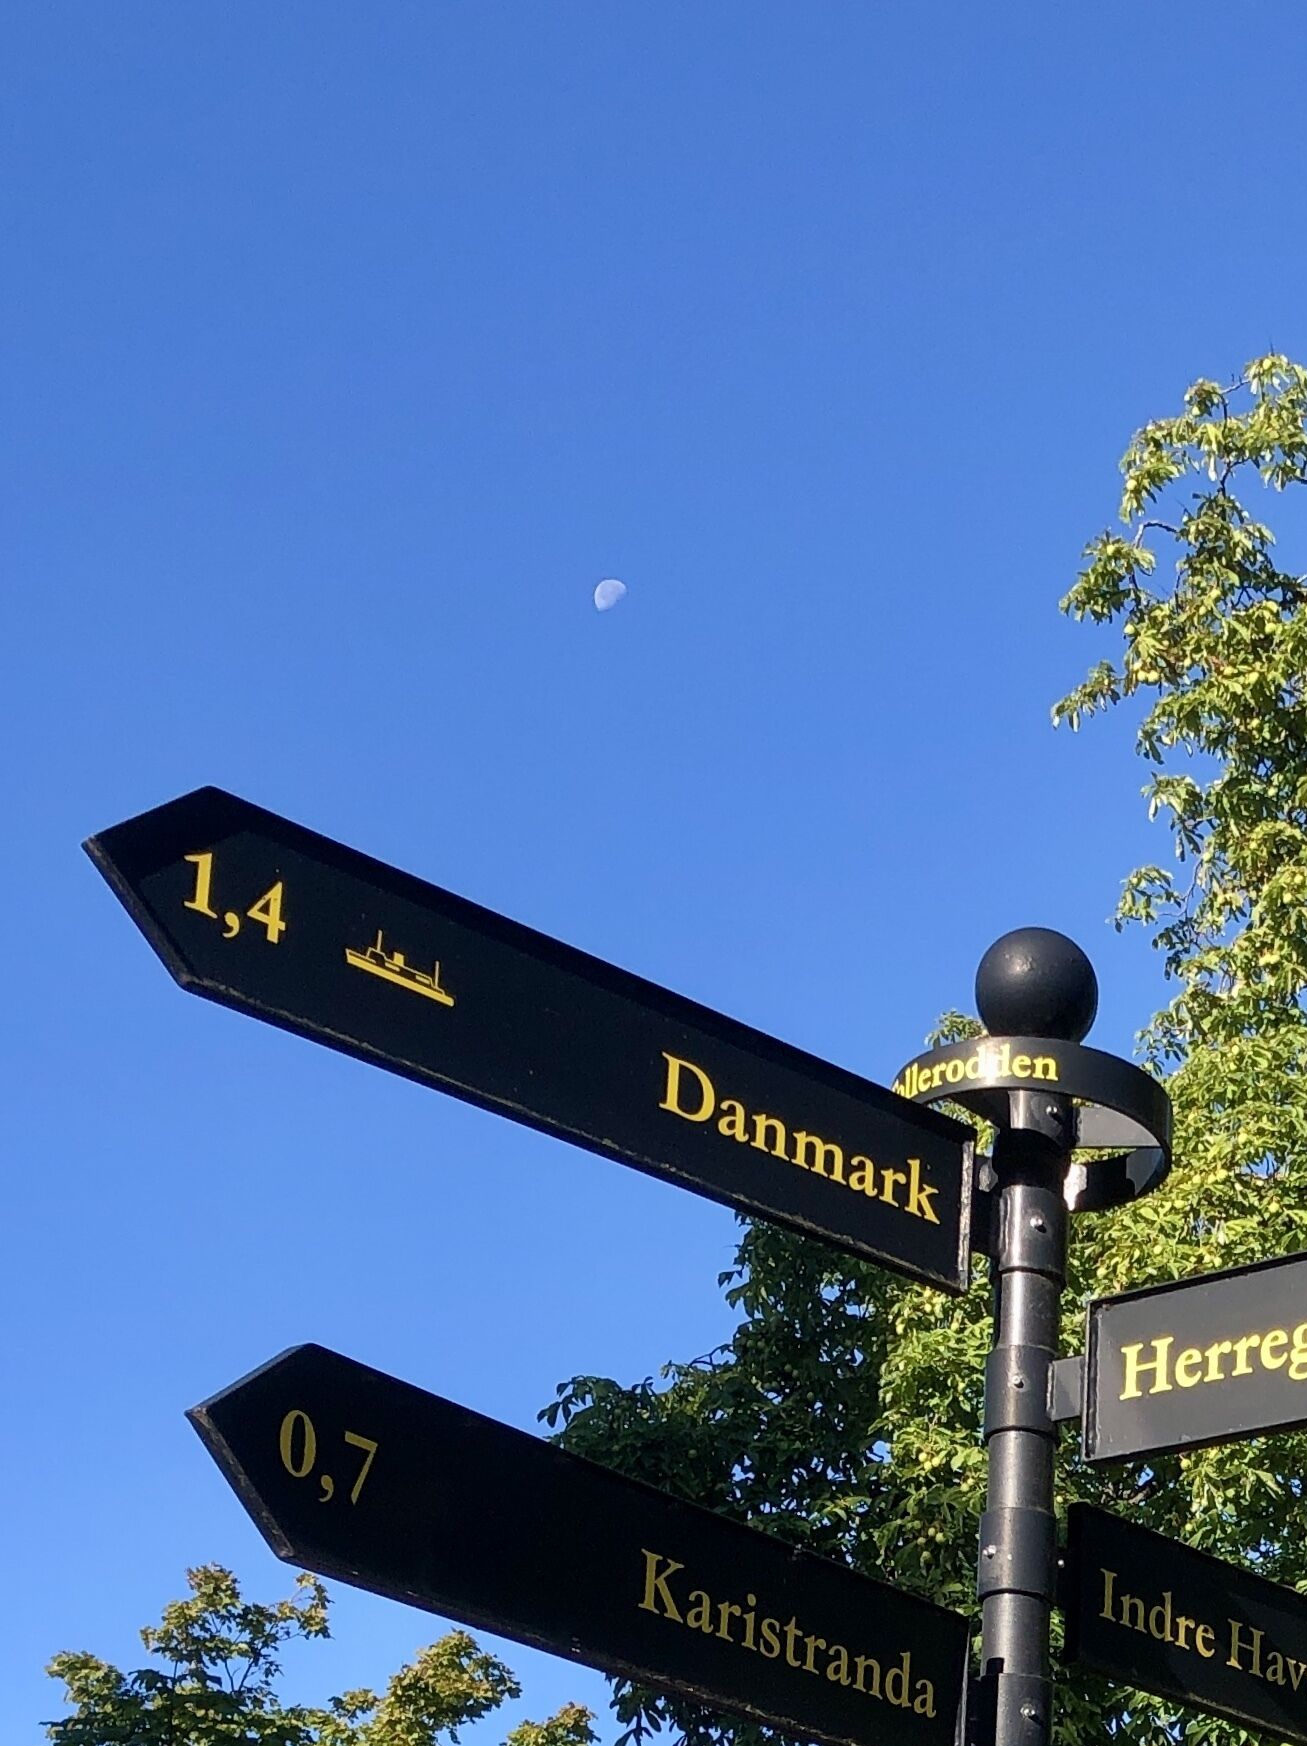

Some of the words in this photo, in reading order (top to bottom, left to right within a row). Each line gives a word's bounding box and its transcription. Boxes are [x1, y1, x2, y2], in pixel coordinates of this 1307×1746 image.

[182, 850, 287, 945] 1,4
[658, 1051, 942, 1226] Danmark
[279, 1409, 379, 1506] 0,7
[638, 1547, 938, 1719] Karistranda
[1099, 1567, 1216, 1659] Indre
